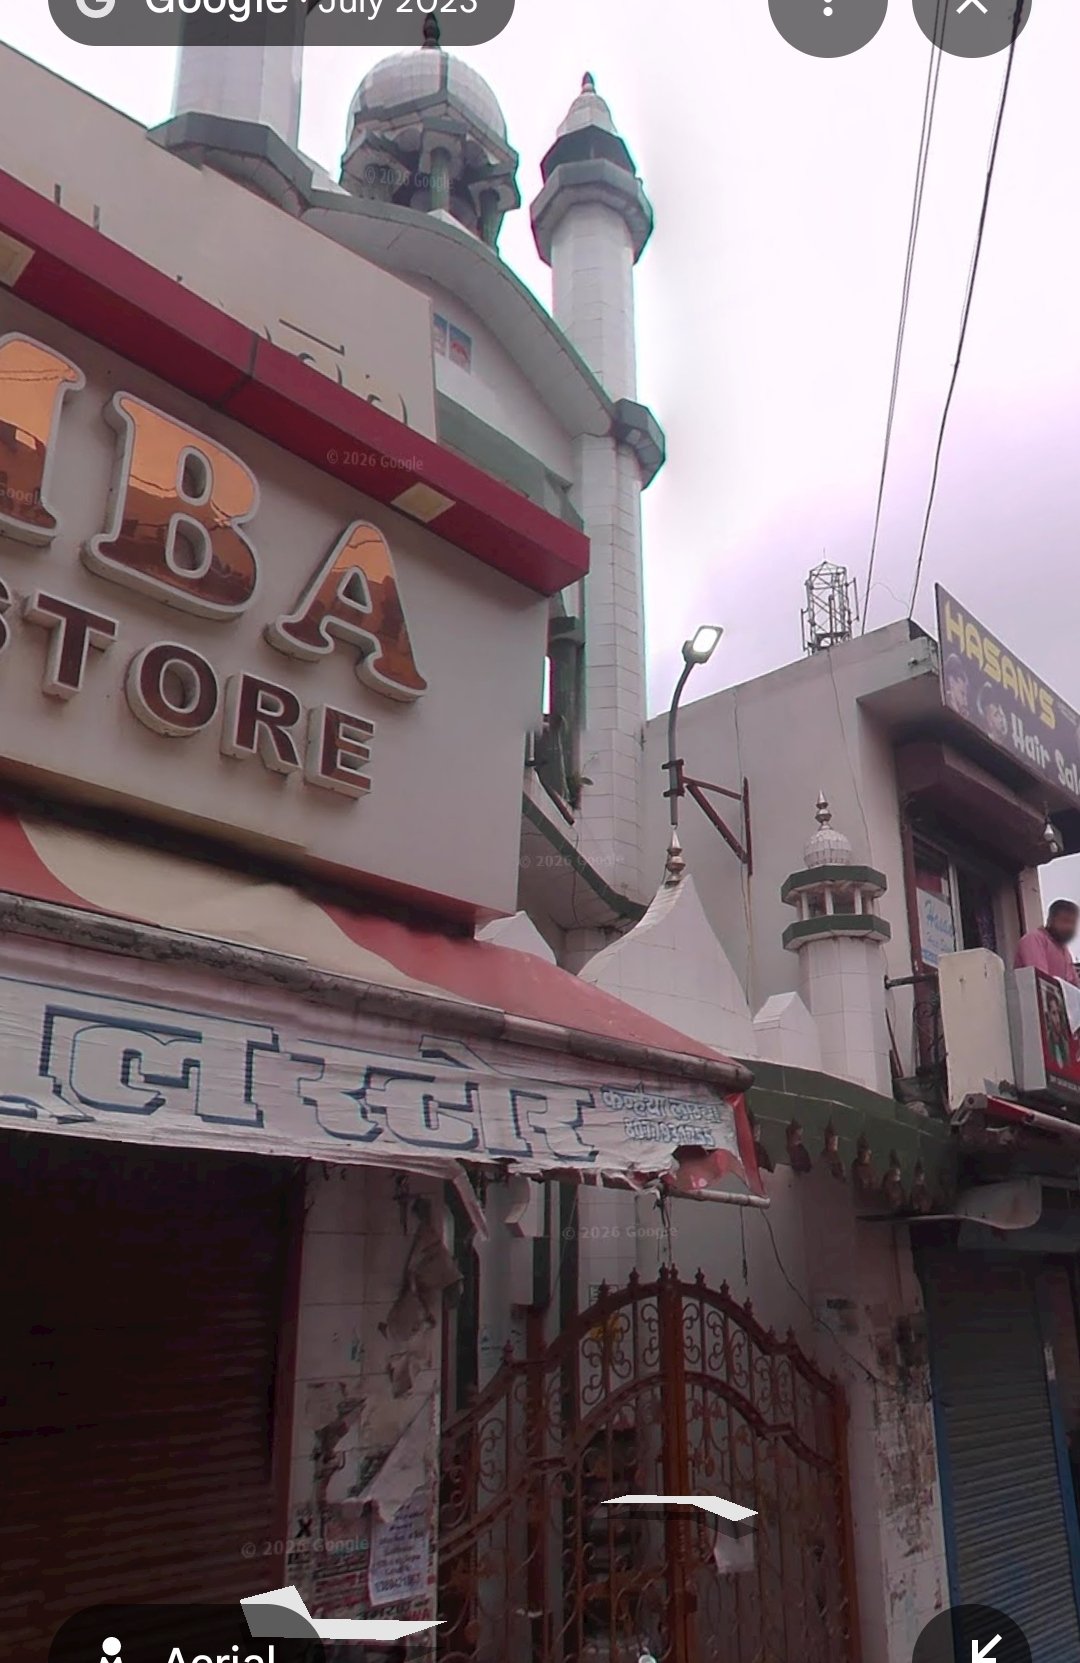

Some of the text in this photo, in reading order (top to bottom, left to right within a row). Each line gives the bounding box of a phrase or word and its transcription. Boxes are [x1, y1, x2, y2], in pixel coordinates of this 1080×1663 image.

[0, 576, 376, 797] TORE
[944, 603, 1056, 729] HASAN'S
[1011, 712, 1050, 769] Hair
[1055, 749, 1080, 796] Sal
